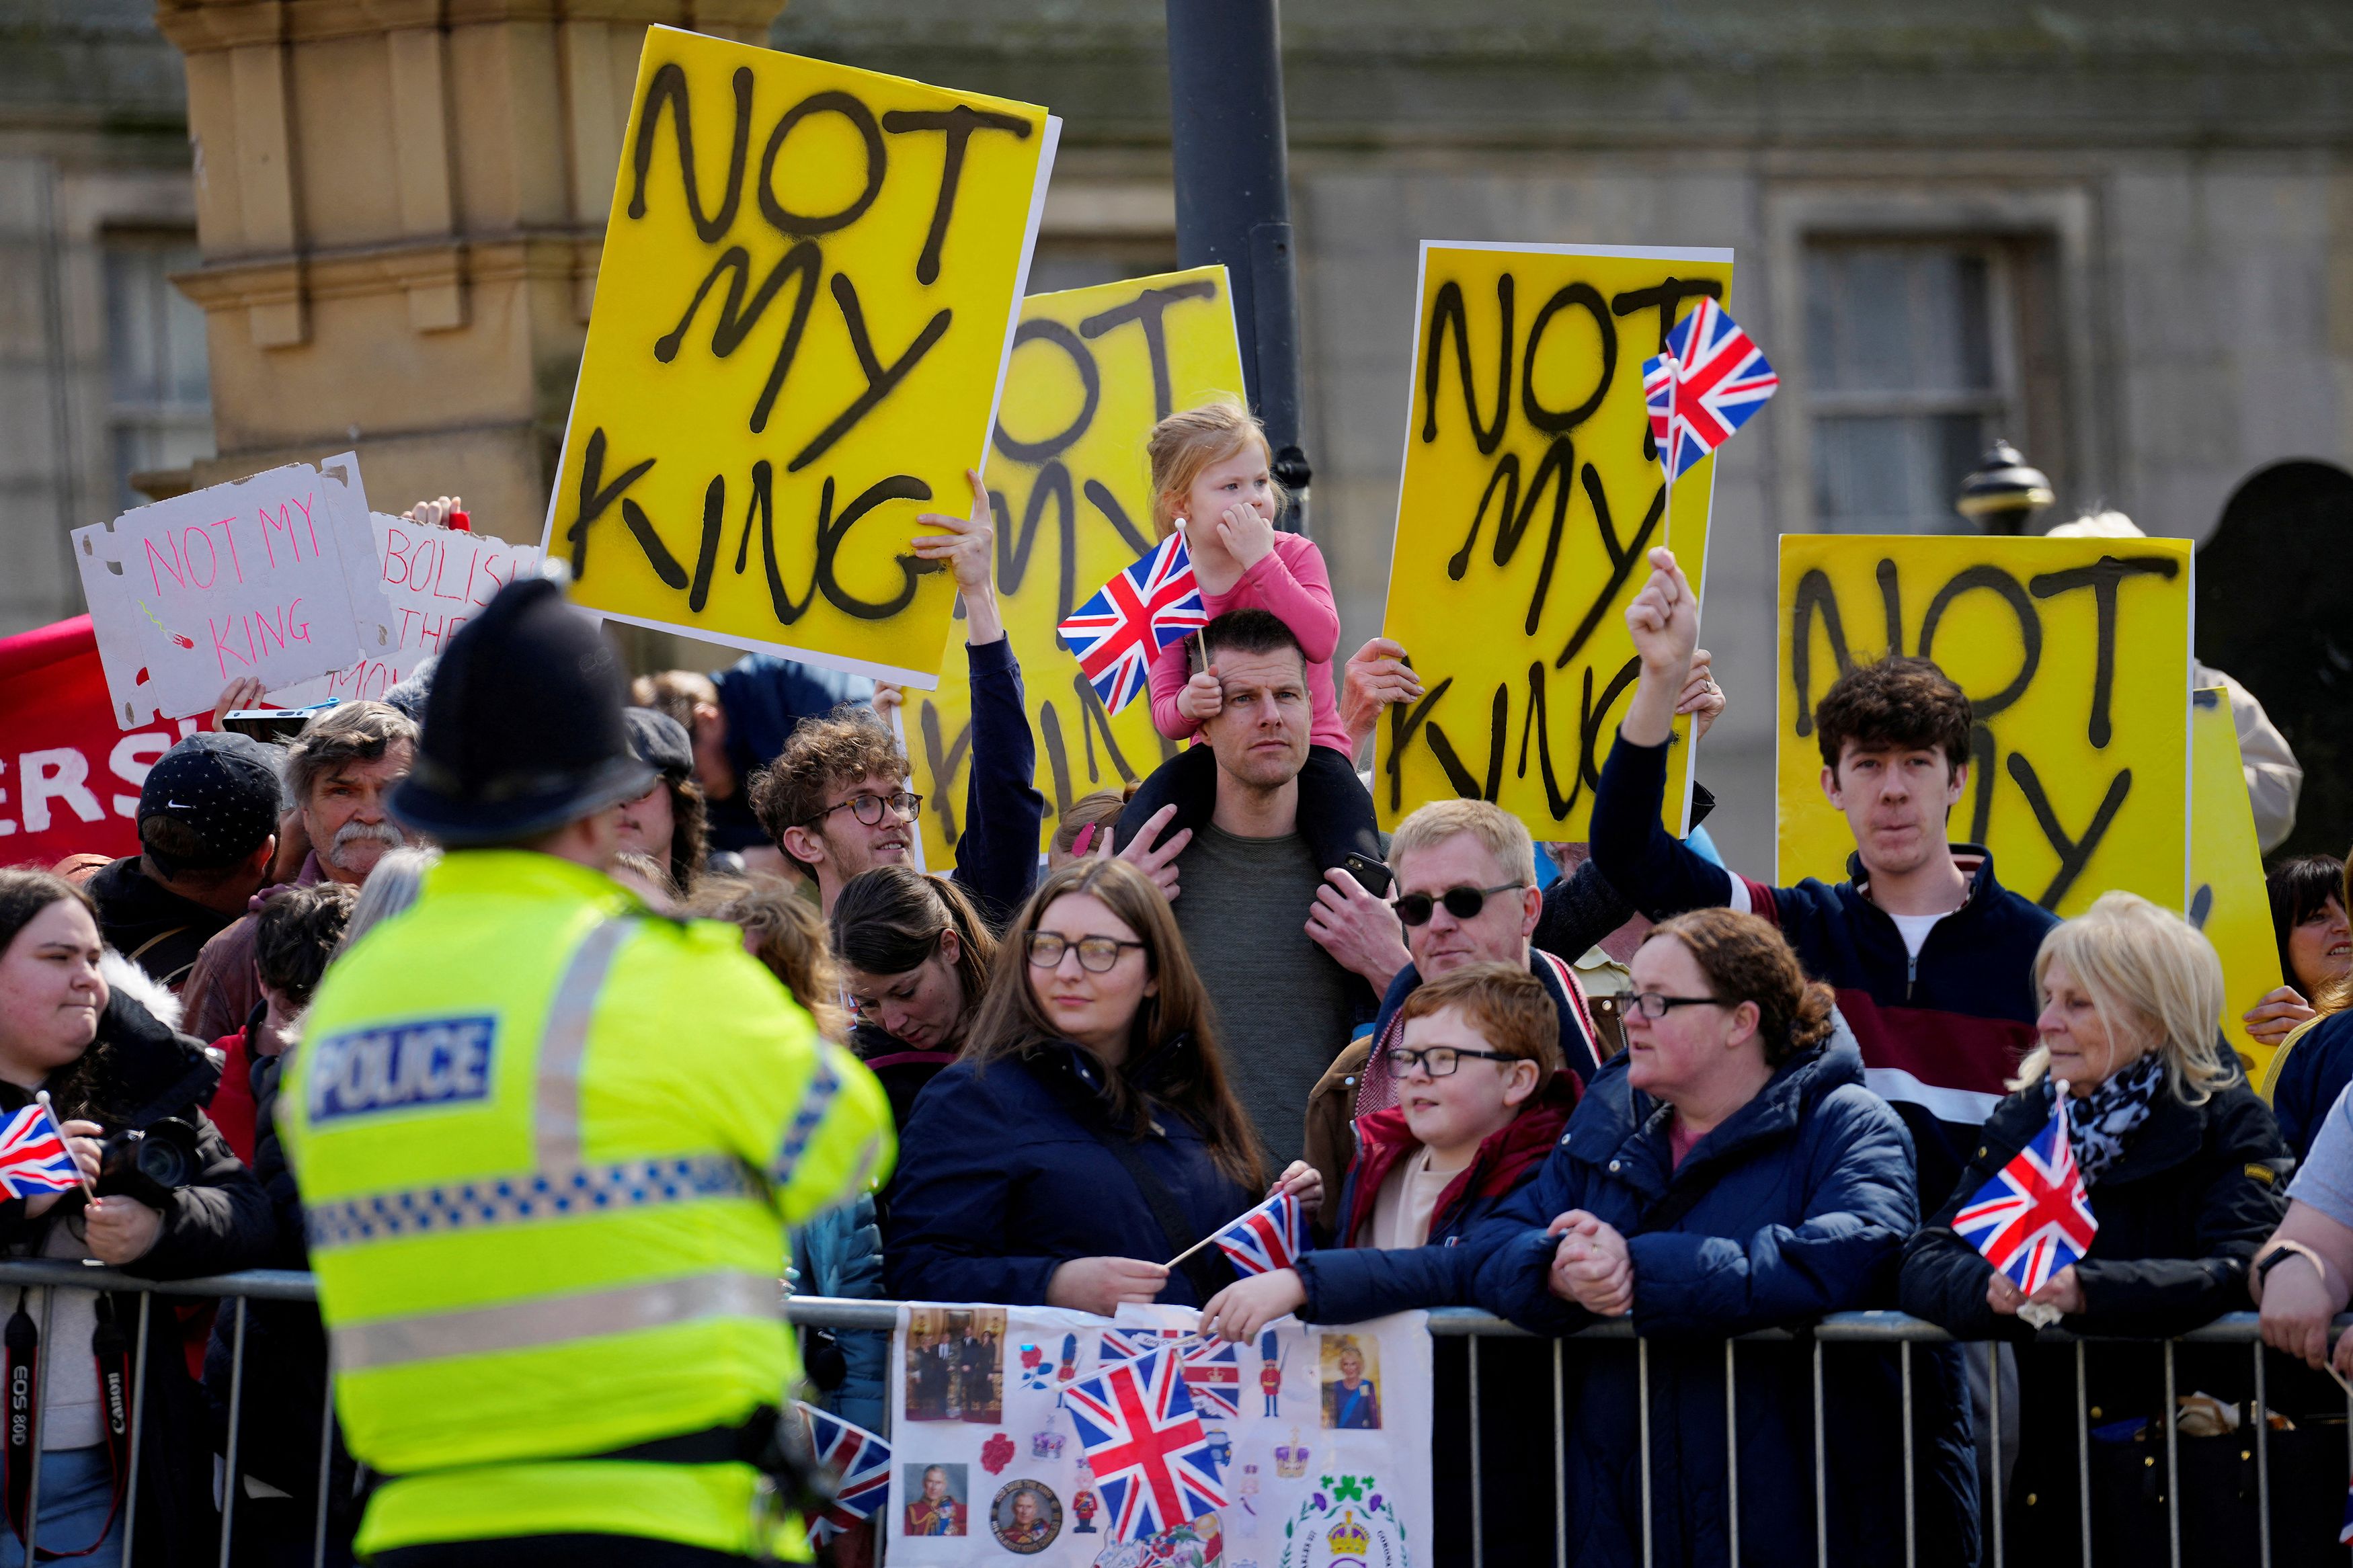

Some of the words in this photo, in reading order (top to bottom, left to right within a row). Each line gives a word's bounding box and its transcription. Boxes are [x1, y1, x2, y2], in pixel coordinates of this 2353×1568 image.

[628, 63, 1033, 287] NOT
[653, 239, 953, 472] MY
[992, 280, 1216, 462] OT
[1422, 273, 1723, 461] NOT
[144, 516, 243, 597] NOT
[259, 492, 320, 569] MY
[383, 528, 534, 607] BOLIS
[567, 426, 947, 626] KING
[1447, 436, 1667, 668] MY
[208, 598, 311, 679] KING
[1792, 555, 2180, 749] NOT
[920, 673, 1181, 845] KIN
[313, 1024, 485, 1118] POLICE
[12, 1414, 28, 1446] 80D
[13, 1365, 29, 1411] EOS
[108, 1372, 126, 1435] Canon
